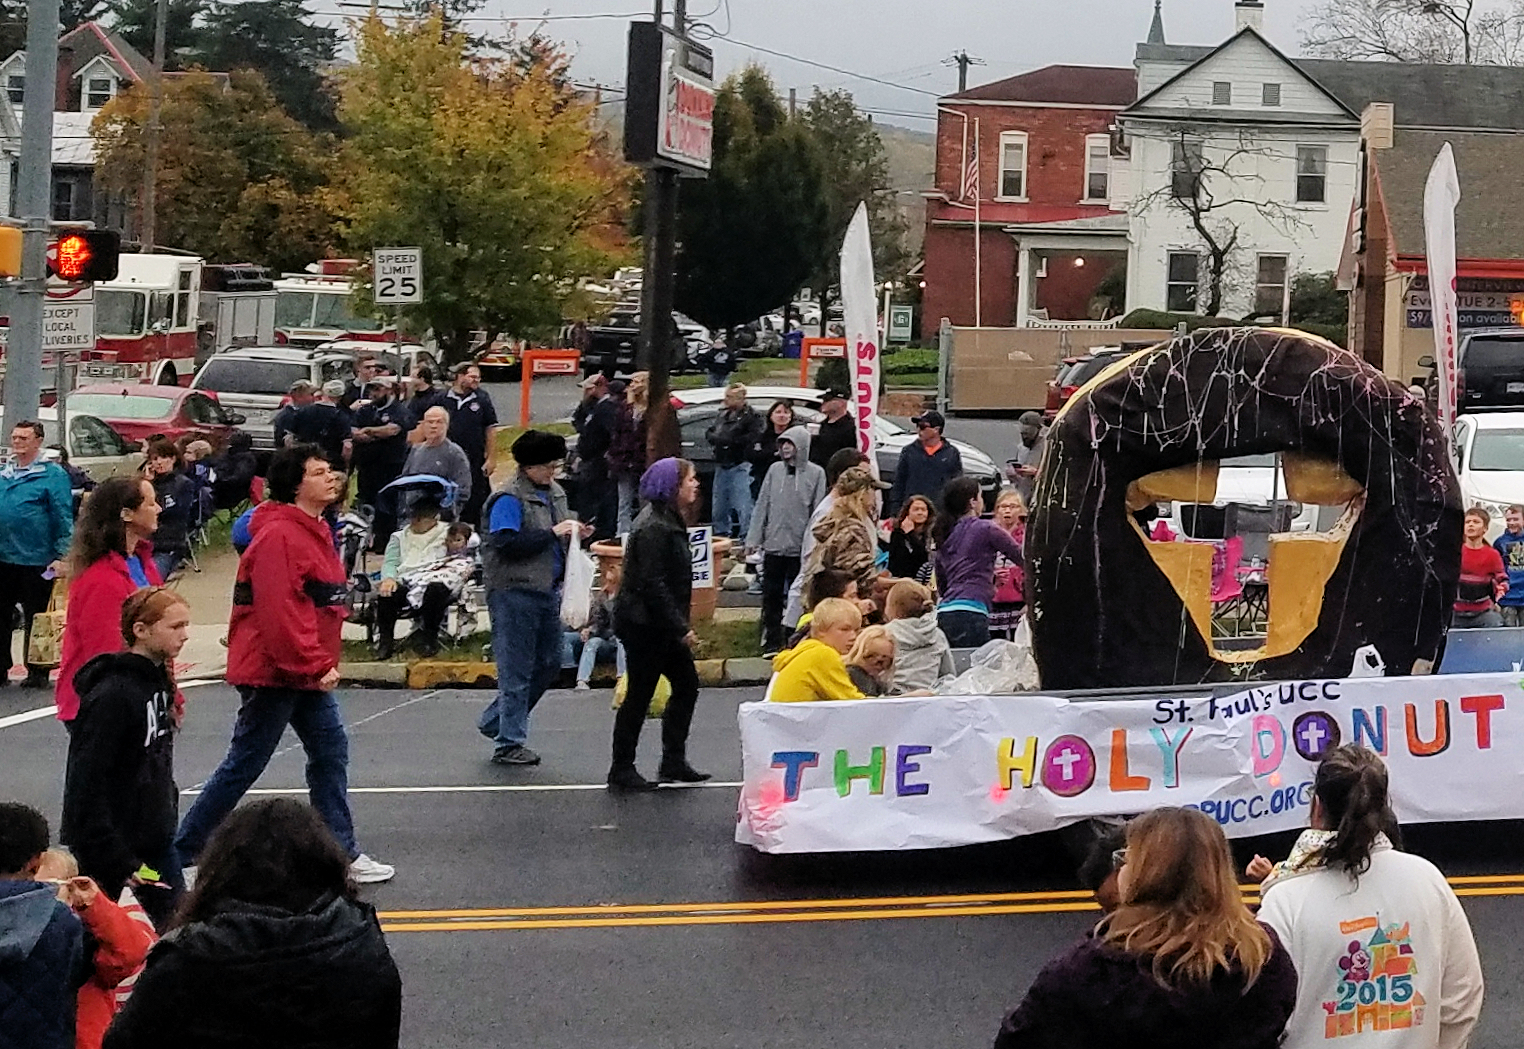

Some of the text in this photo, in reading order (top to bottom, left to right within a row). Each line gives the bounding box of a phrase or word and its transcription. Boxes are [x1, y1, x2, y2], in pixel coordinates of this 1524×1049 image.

[378, 254, 416, 263] SPEED
[381, 265, 412, 275] LIMIT
[378, 277, 416, 297] 25
[42, 308, 79, 318] EXCEPT
[45, 322, 76, 332] LOCAL
[42, 335, 89, 345] LIVERIES
[1152, 699, 1194, 724] St.
[770, 694, 1506, 802] THE HOLY DONUT
[1335, 974, 1414, 1012] 2015
